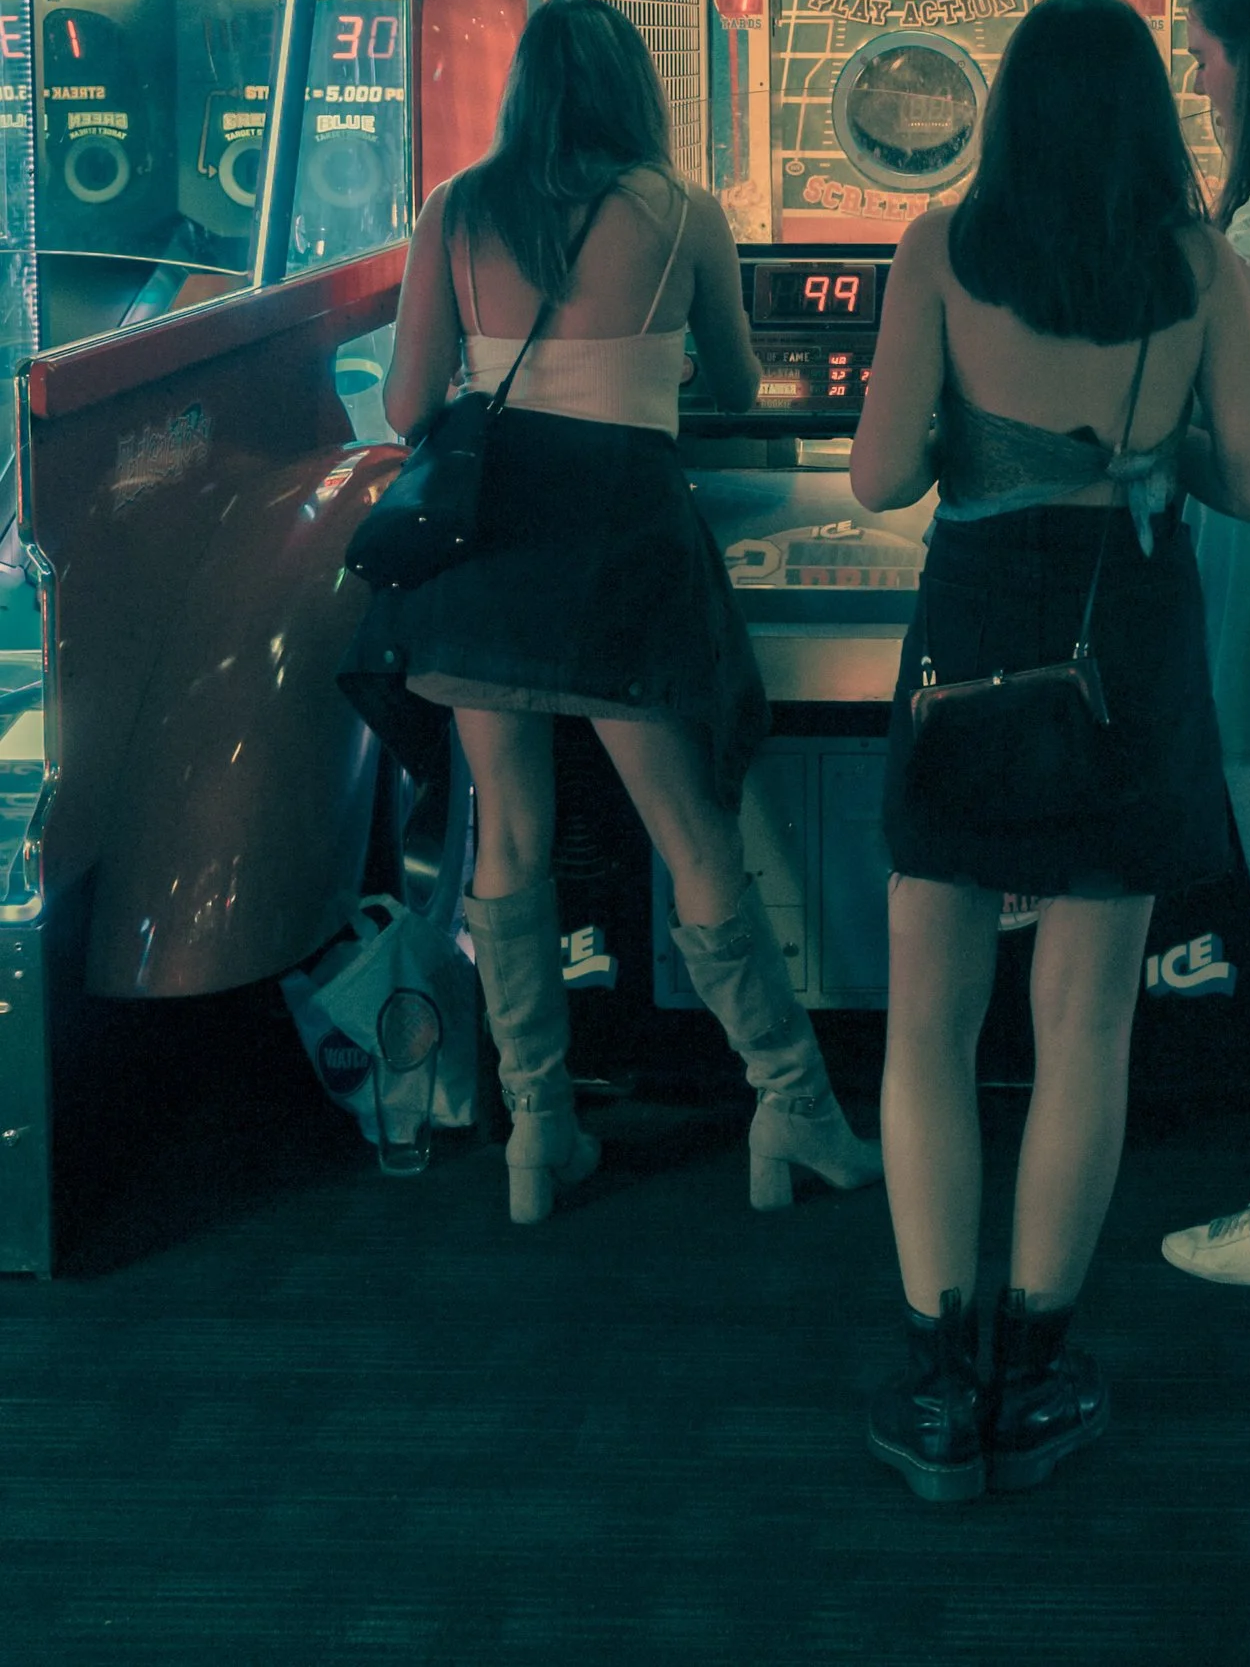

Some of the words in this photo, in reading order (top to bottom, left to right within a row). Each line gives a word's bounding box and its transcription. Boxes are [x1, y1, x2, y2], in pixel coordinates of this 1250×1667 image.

[332, 15, 398, 59] 30
[325, 85, 383, 102] 5,000
[222, 112, 267, 131] GRE
[316, 114, 376, 133] BLUE
[803, 174, 930, 221] SCREEN
[804, 275, 860, 312] 99
[783, 351, 811, 362] FAME
[811, 519, 862, 540] ICE
[725, 538, 782, 589] 2
[1146, 933, 1230, 989] ICE
